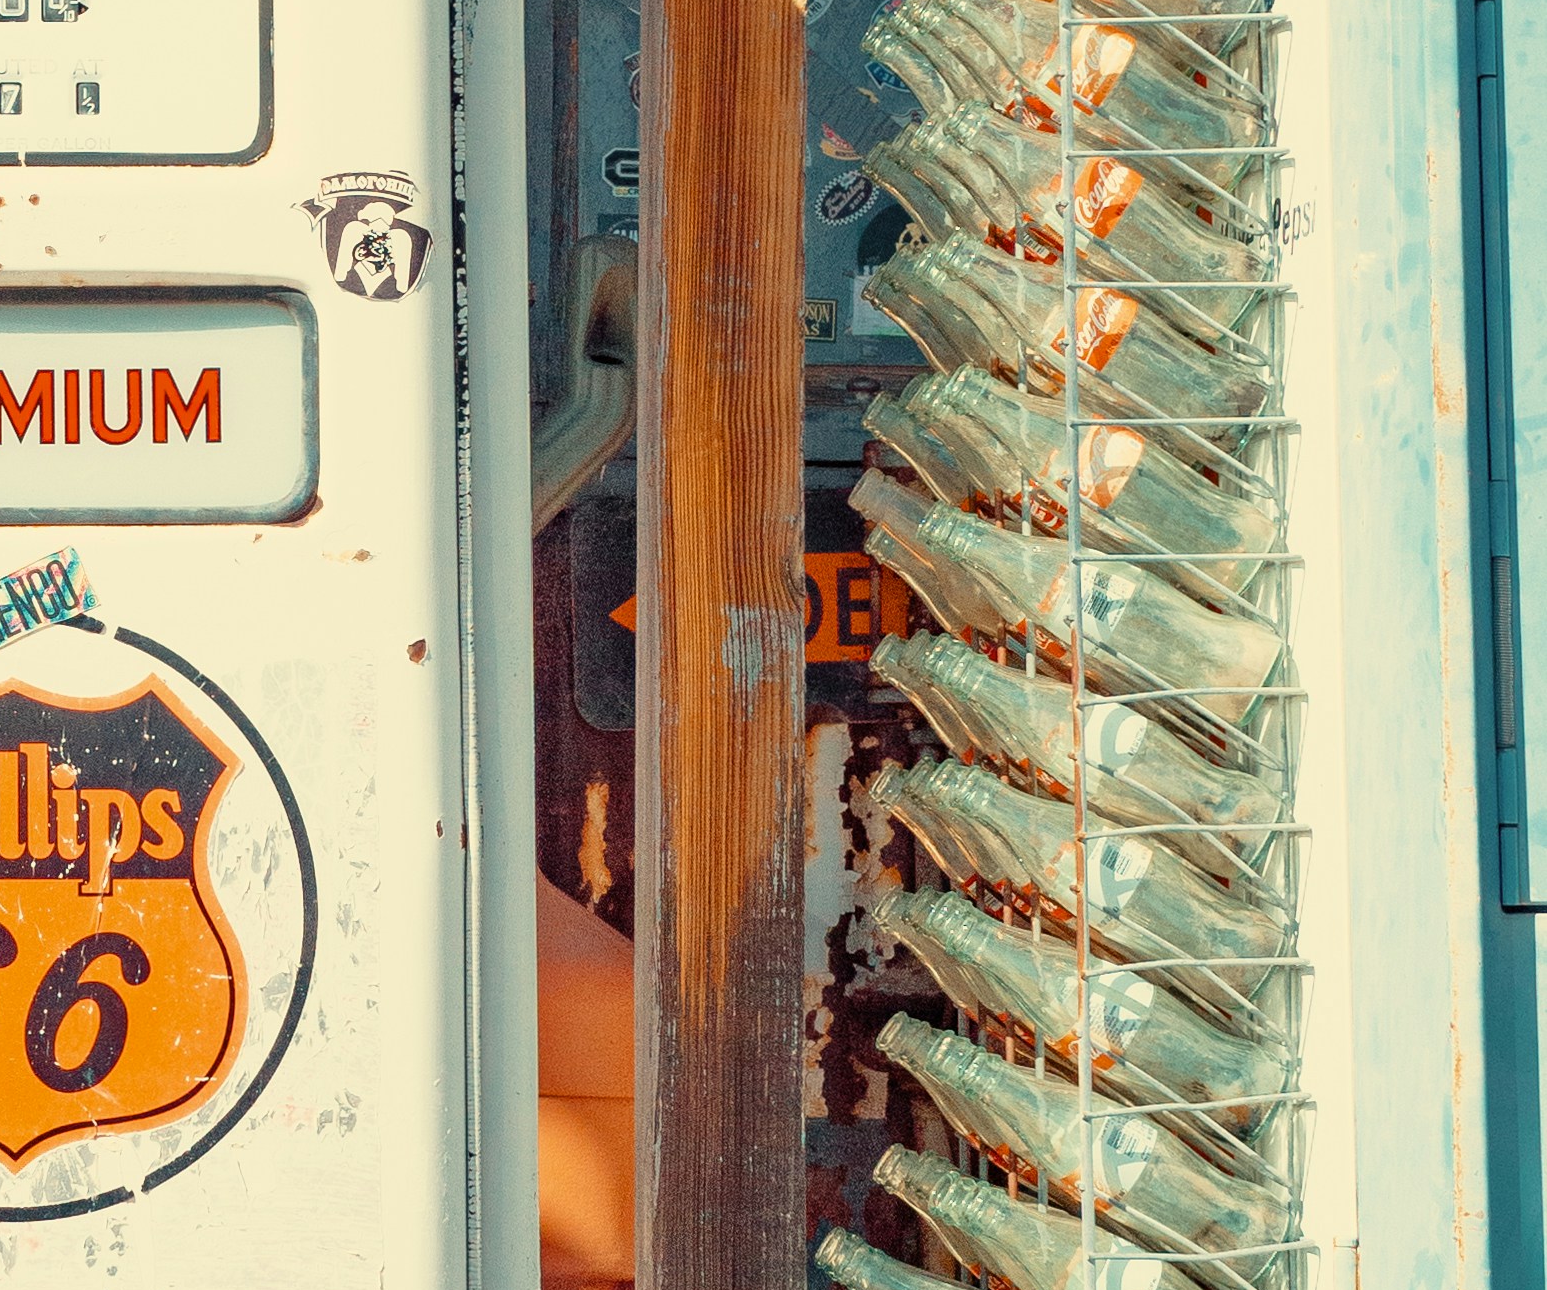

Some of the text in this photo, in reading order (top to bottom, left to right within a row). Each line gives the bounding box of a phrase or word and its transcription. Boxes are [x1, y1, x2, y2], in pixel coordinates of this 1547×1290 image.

[71, 58, 105, 76] AT
[0, 83, 22, 113] 7
[37, 137, 112, 151] GALLON
[1273, 185, 1318, 256] Pepsi
